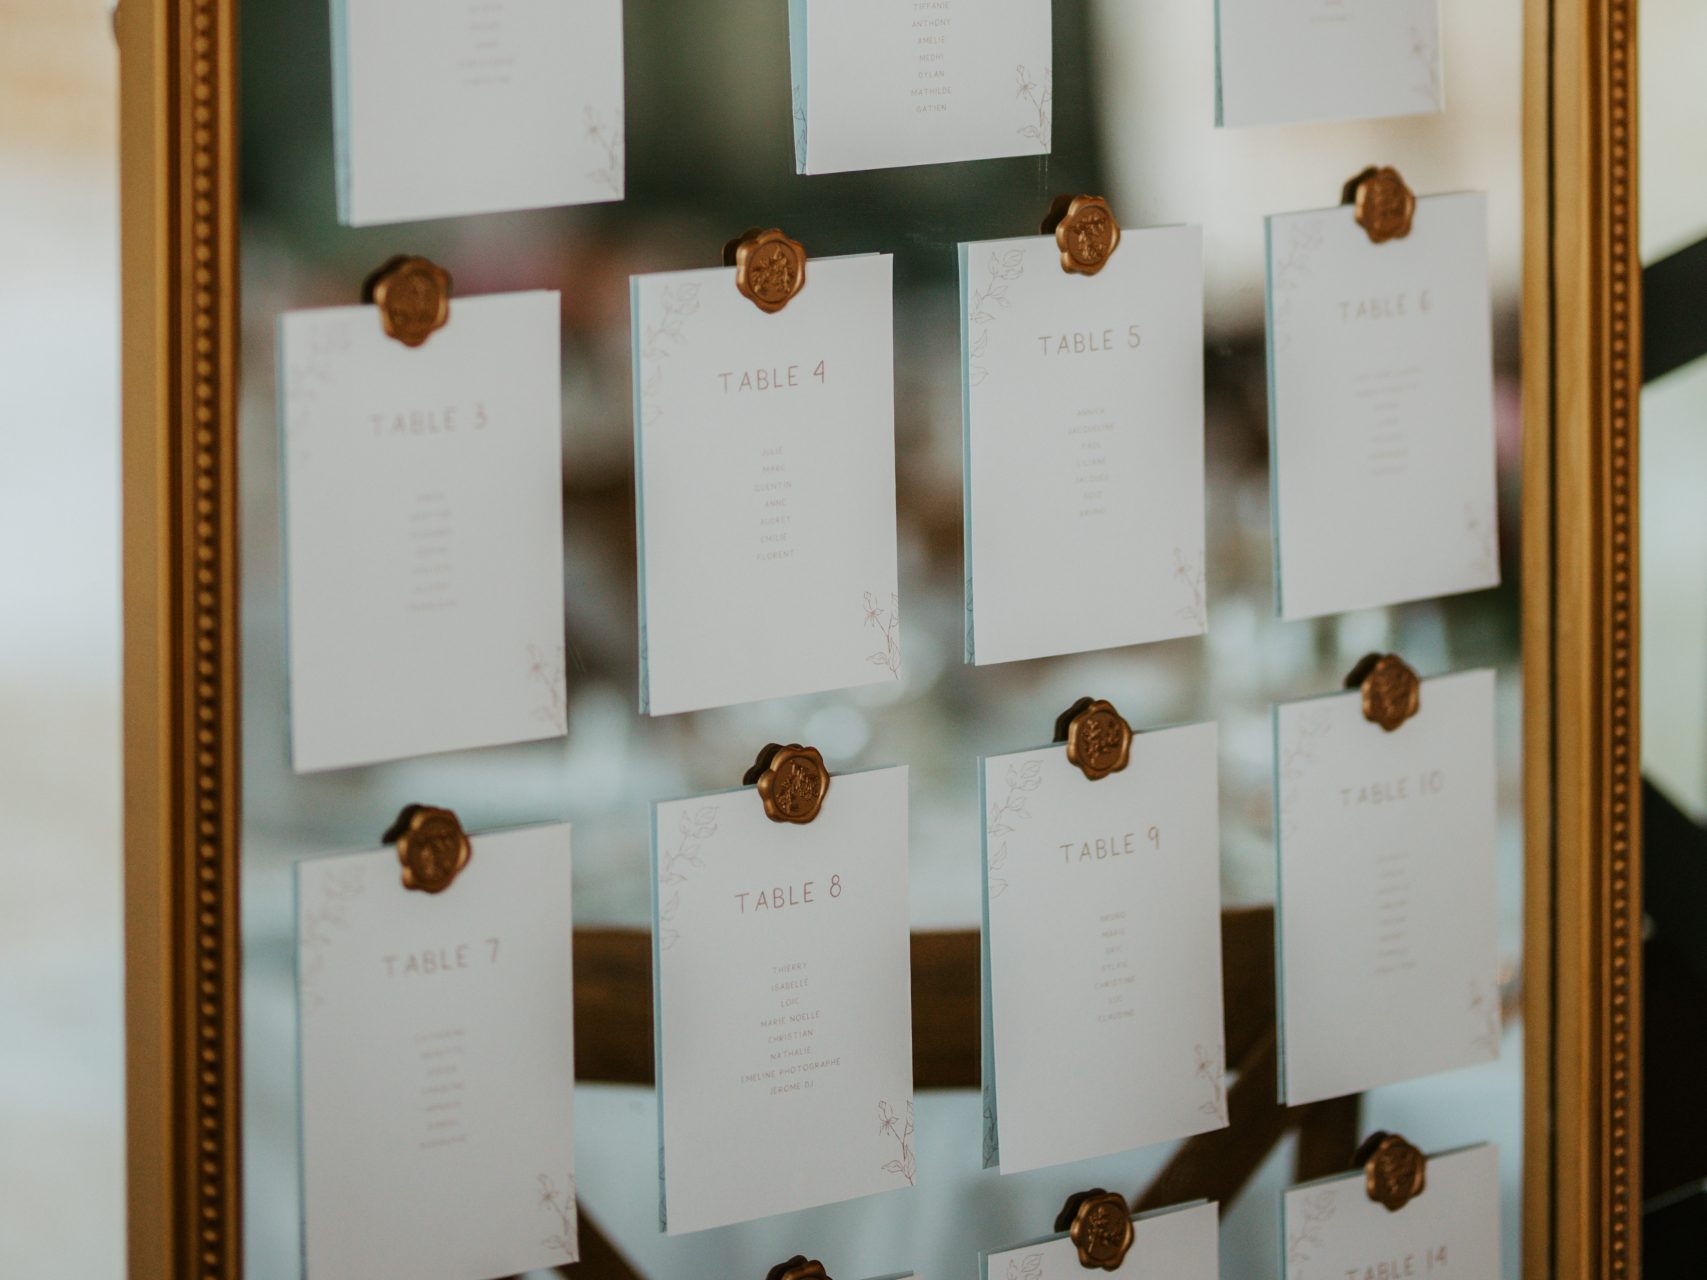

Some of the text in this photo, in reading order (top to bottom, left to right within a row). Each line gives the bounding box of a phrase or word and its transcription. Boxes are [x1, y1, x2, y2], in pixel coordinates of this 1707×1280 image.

[910, 86, 951, 96] MATHILDE
[1338, 287, 1431, 322] TABLE 6
[1038, 324, 1141, 356] TABLE 5
[717, 359, 825, 394] TABLE 4
[369, 401, 488, 438] TABLE 3
[1340, 768, 1445, 808] TABLE 10
[1059, 825, 1160, 864] TABLE 9
[734, 873, 842, 915] TABLE 8
[383, 937, 500, 978] TABLE 7
[1344, 1245, 1448, 1280] TABLE 14
